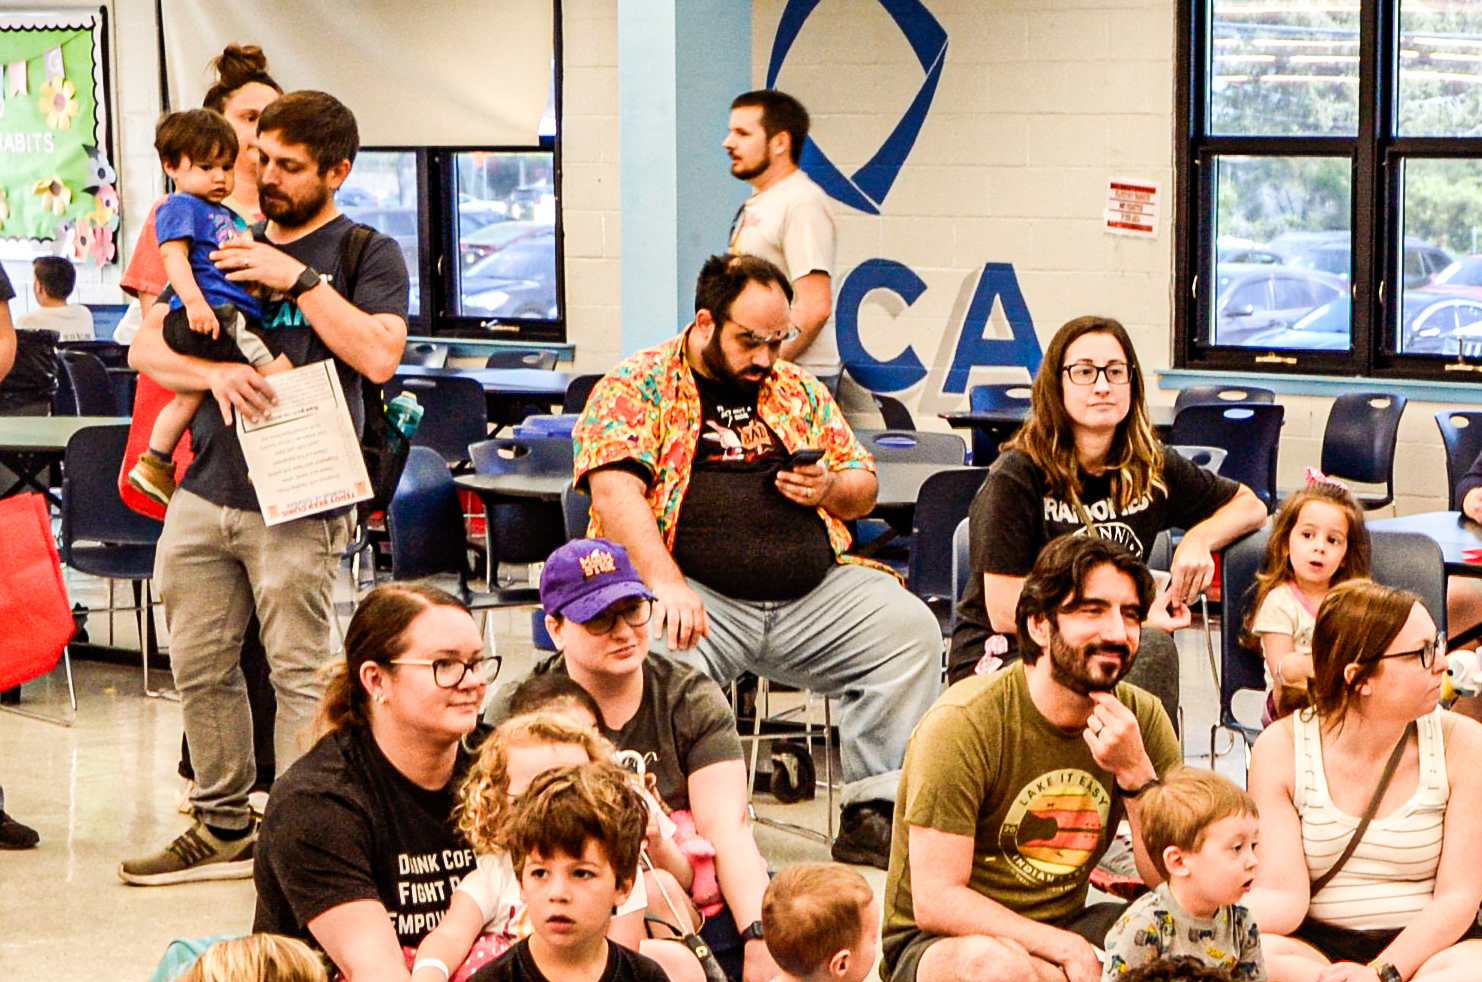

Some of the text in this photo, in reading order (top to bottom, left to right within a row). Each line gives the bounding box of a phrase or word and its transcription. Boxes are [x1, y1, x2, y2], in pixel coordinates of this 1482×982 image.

[1020, 777, 1052, 807] LAKE
[1079, 775, 1108, 806] EASY
[398, 881, 445, 905] FIGHT
